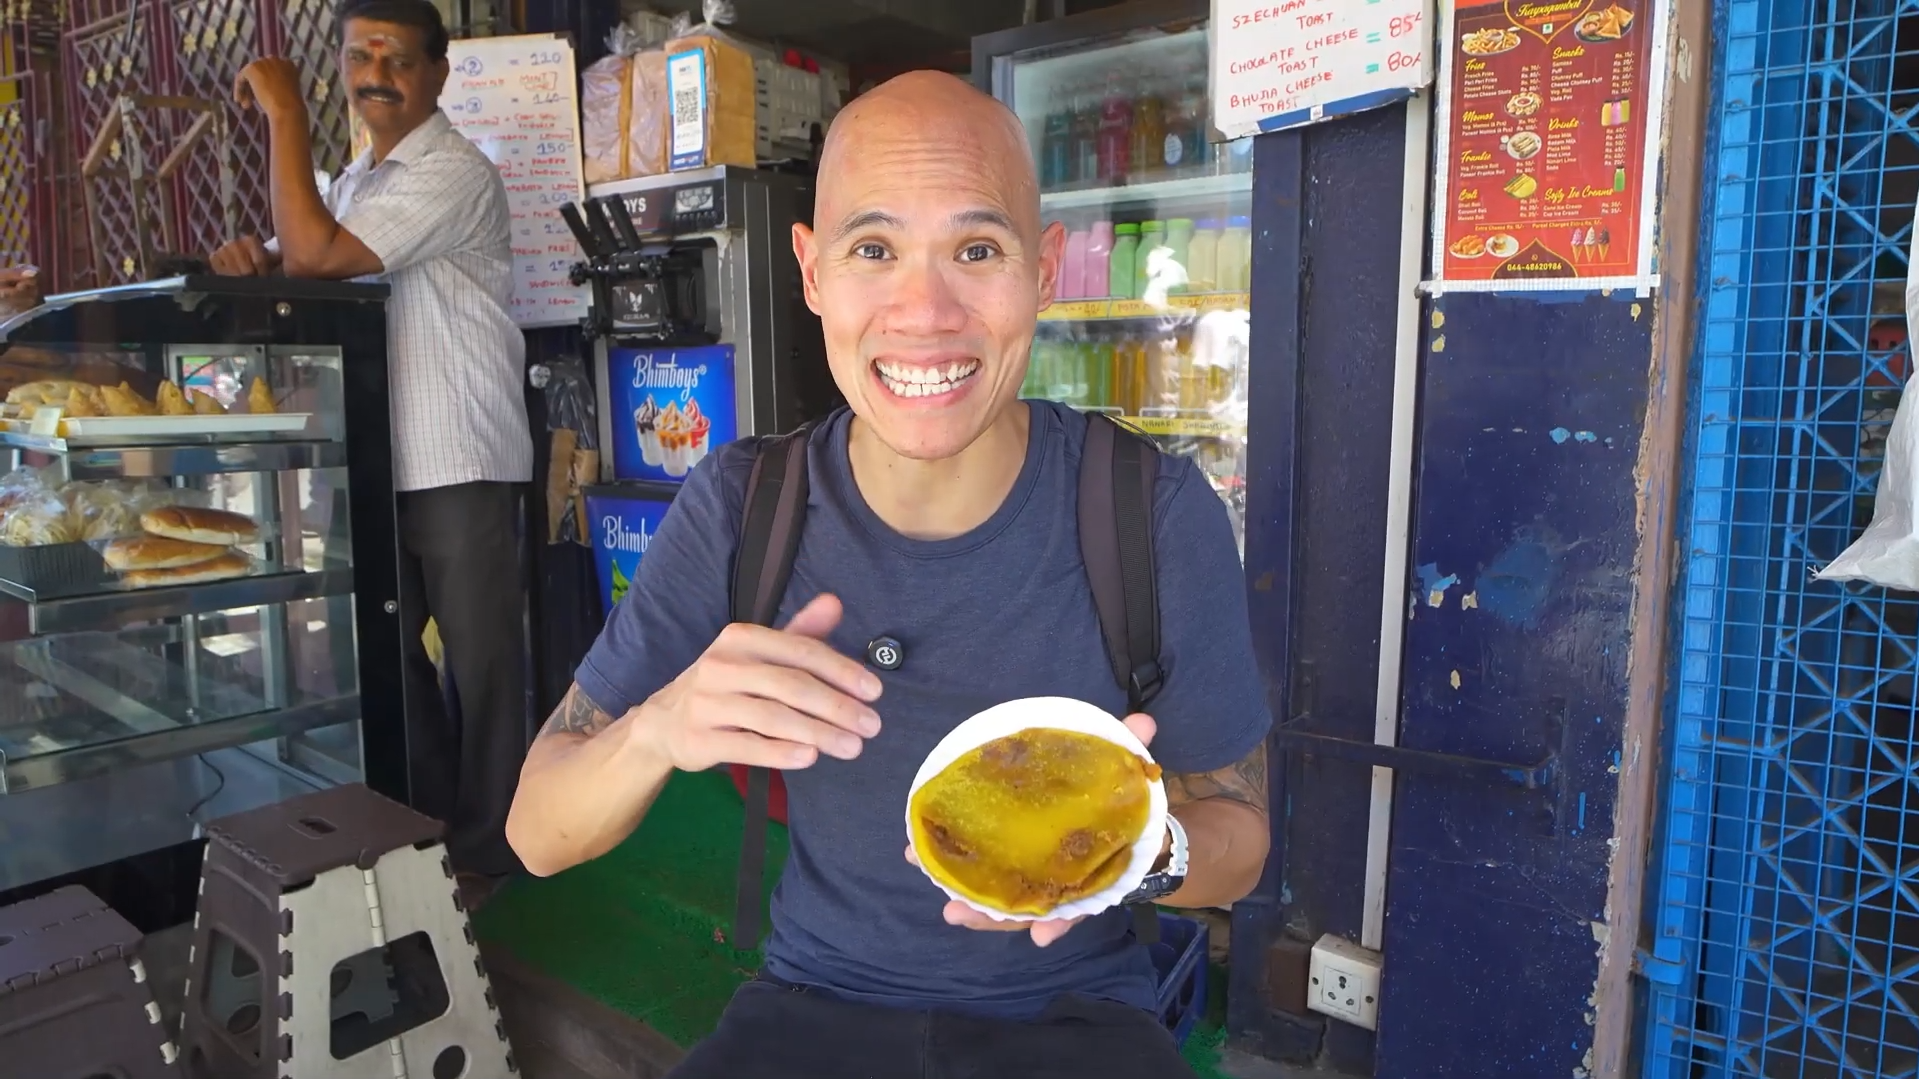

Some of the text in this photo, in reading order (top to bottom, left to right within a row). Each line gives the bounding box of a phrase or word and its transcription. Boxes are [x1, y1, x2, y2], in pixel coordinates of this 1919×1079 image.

[1232, 0, 1306, 29] SZECHUAN
[1296, 12, 1333, 29] TOAST
[1306, 28, 1358, 50] CHEESE
[1552, 46, 1585, 59] Snacks
[1278, 56, 1318, 75] TOAST
[1465, 58, 1486, 71] Fries
[1286, 71, 1333, 94] CHEESE
[1259, 96, 1300, 113] TOAST
[1462, 111, 1494, 122] Momos
[1549, 118, 1579, 131] Drinks
[1461, 150, 1491, 163] Frankie
[1568, 186, 1580, 198] Ice
[1582, 185, 1614, 198] Creams
